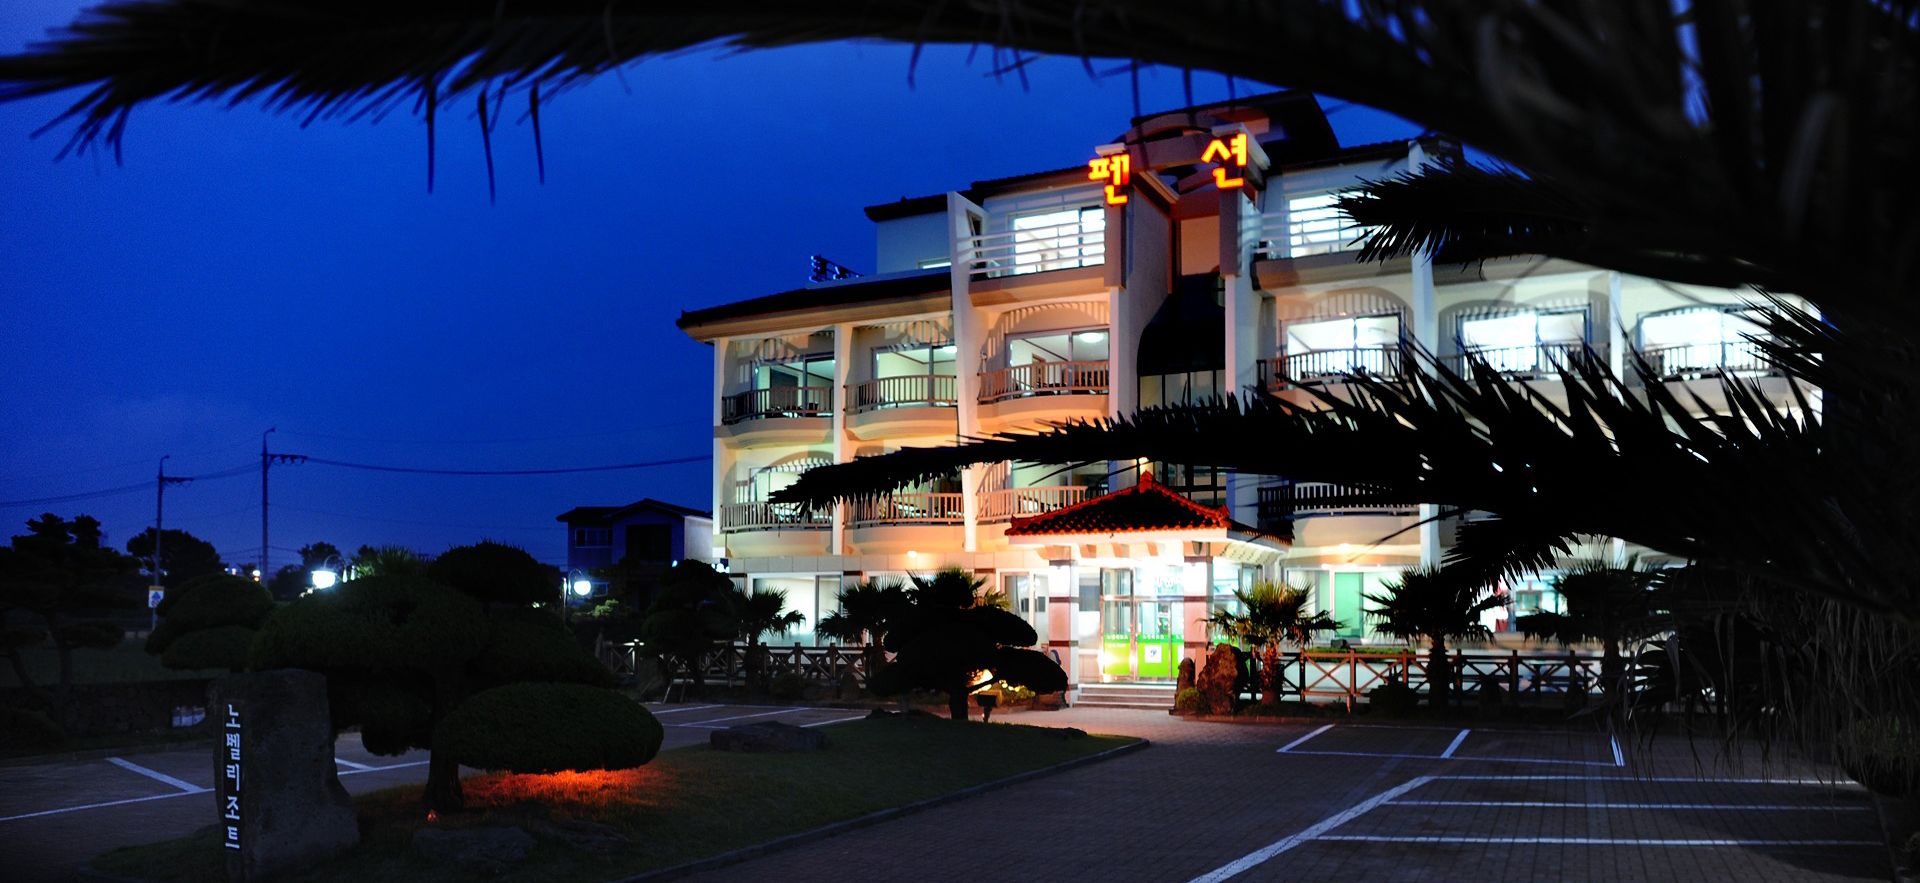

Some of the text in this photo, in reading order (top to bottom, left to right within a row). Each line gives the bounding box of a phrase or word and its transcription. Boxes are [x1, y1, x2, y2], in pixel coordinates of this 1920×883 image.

[1088, 133, 1247, 205] 펜 션
[224, 703, 241, 850] 노벨리조트
